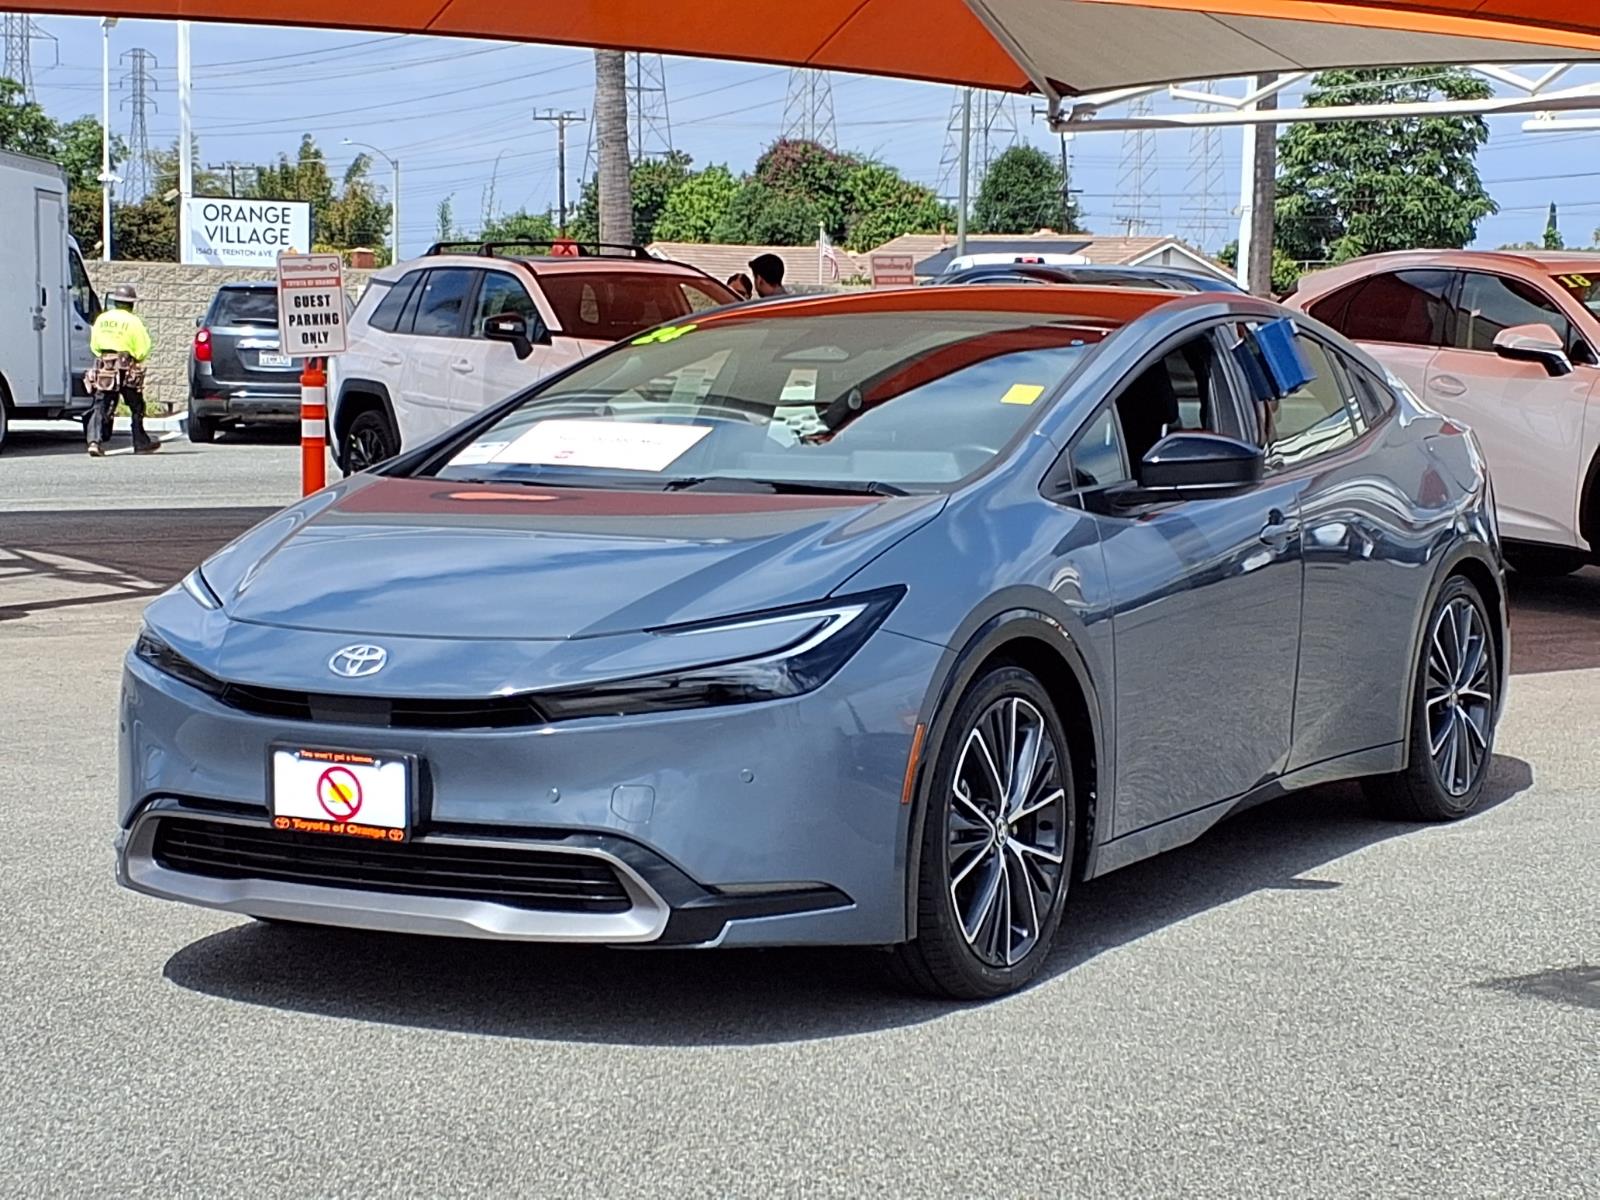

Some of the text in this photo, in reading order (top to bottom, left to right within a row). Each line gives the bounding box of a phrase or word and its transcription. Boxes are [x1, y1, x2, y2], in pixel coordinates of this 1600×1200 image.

[203, 203, 291, 224] ORANGE
[204, 225, 290, 245] VILLAGE
[222, 248, 256, 257] TRENTON
[1558, 274, 1592, 288] 18
[294, 294, 331, 308] GUEST
[288, 312, 340, 327] PARKING
[301, 331, 329, 345] ONLY
[292, 818, 386, 839] Toyota of Orange
